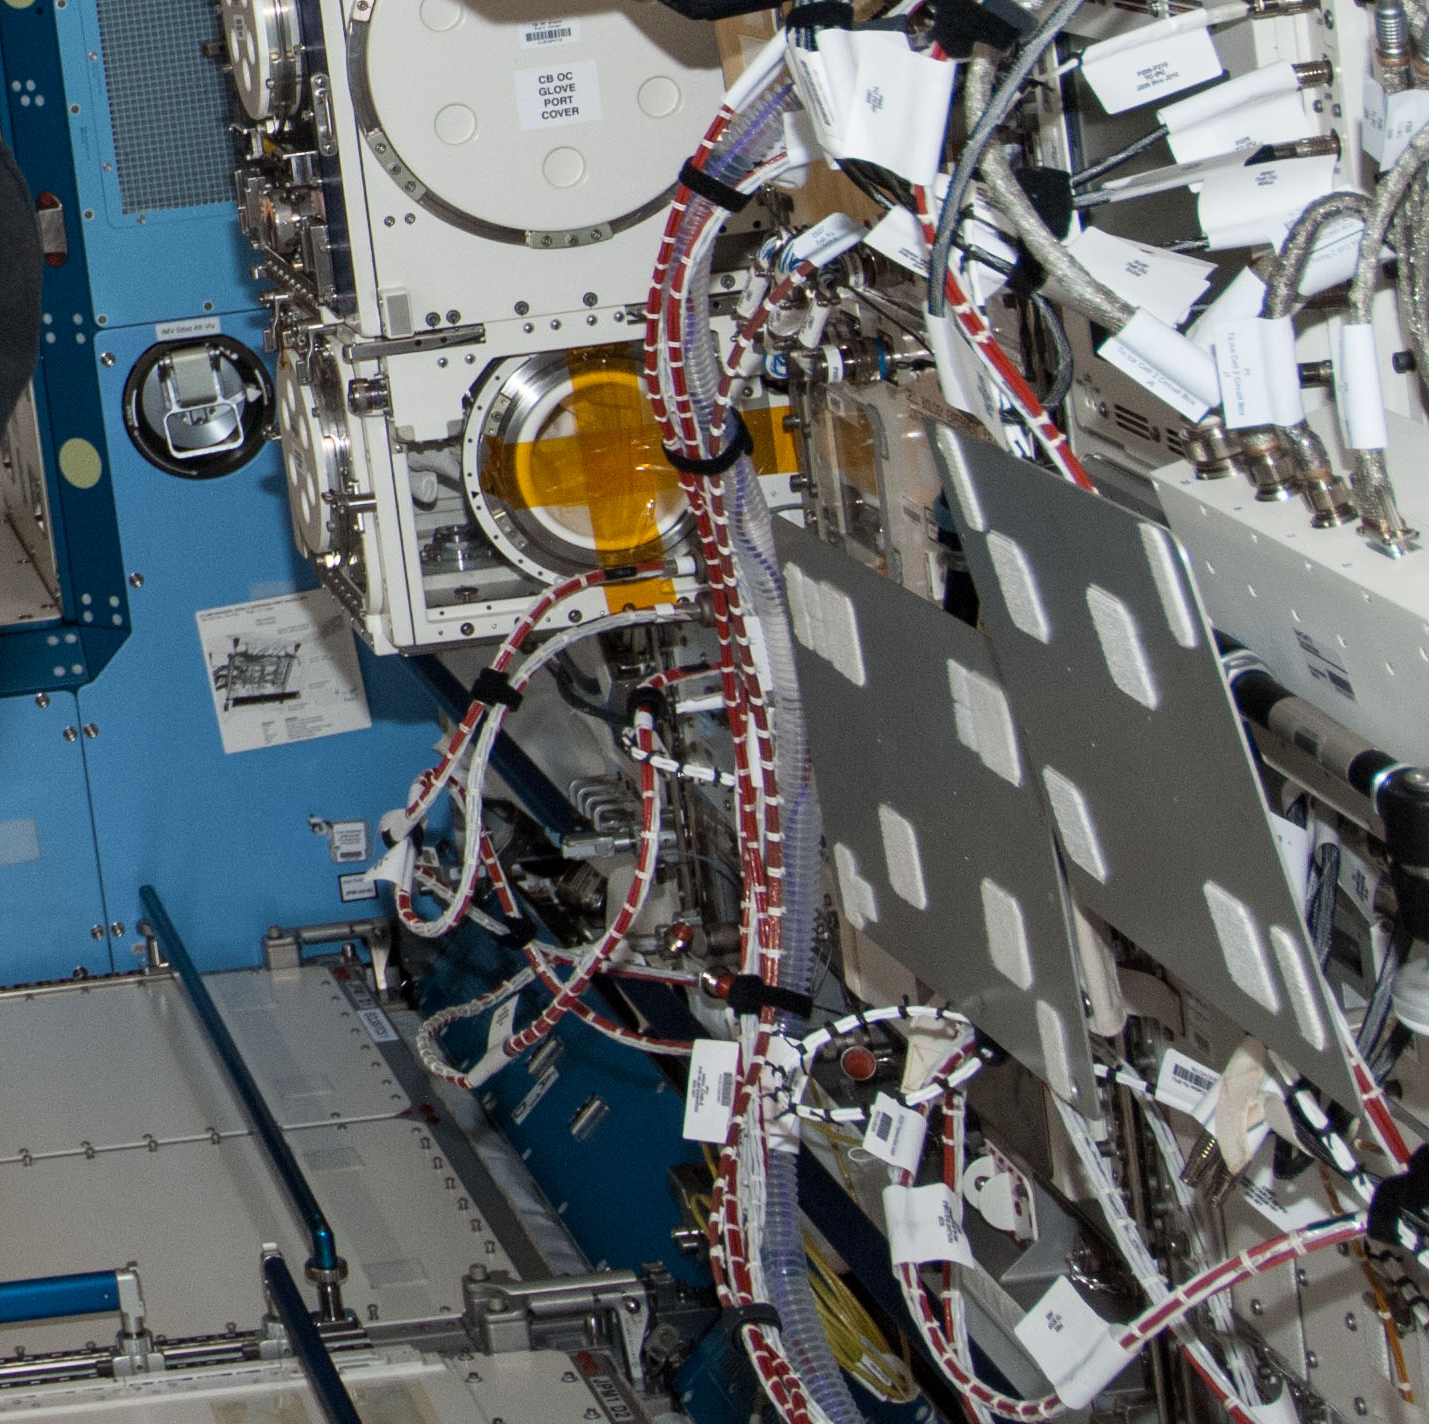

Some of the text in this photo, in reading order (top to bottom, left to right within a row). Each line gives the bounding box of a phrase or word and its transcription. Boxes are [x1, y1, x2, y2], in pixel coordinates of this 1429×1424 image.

[538, 72, 573, 84] CB OC
[539, 83, 576, 96] GLOVE
[544, 96, 574, 107] PORT
[541, 107, 579, 119] COVER
